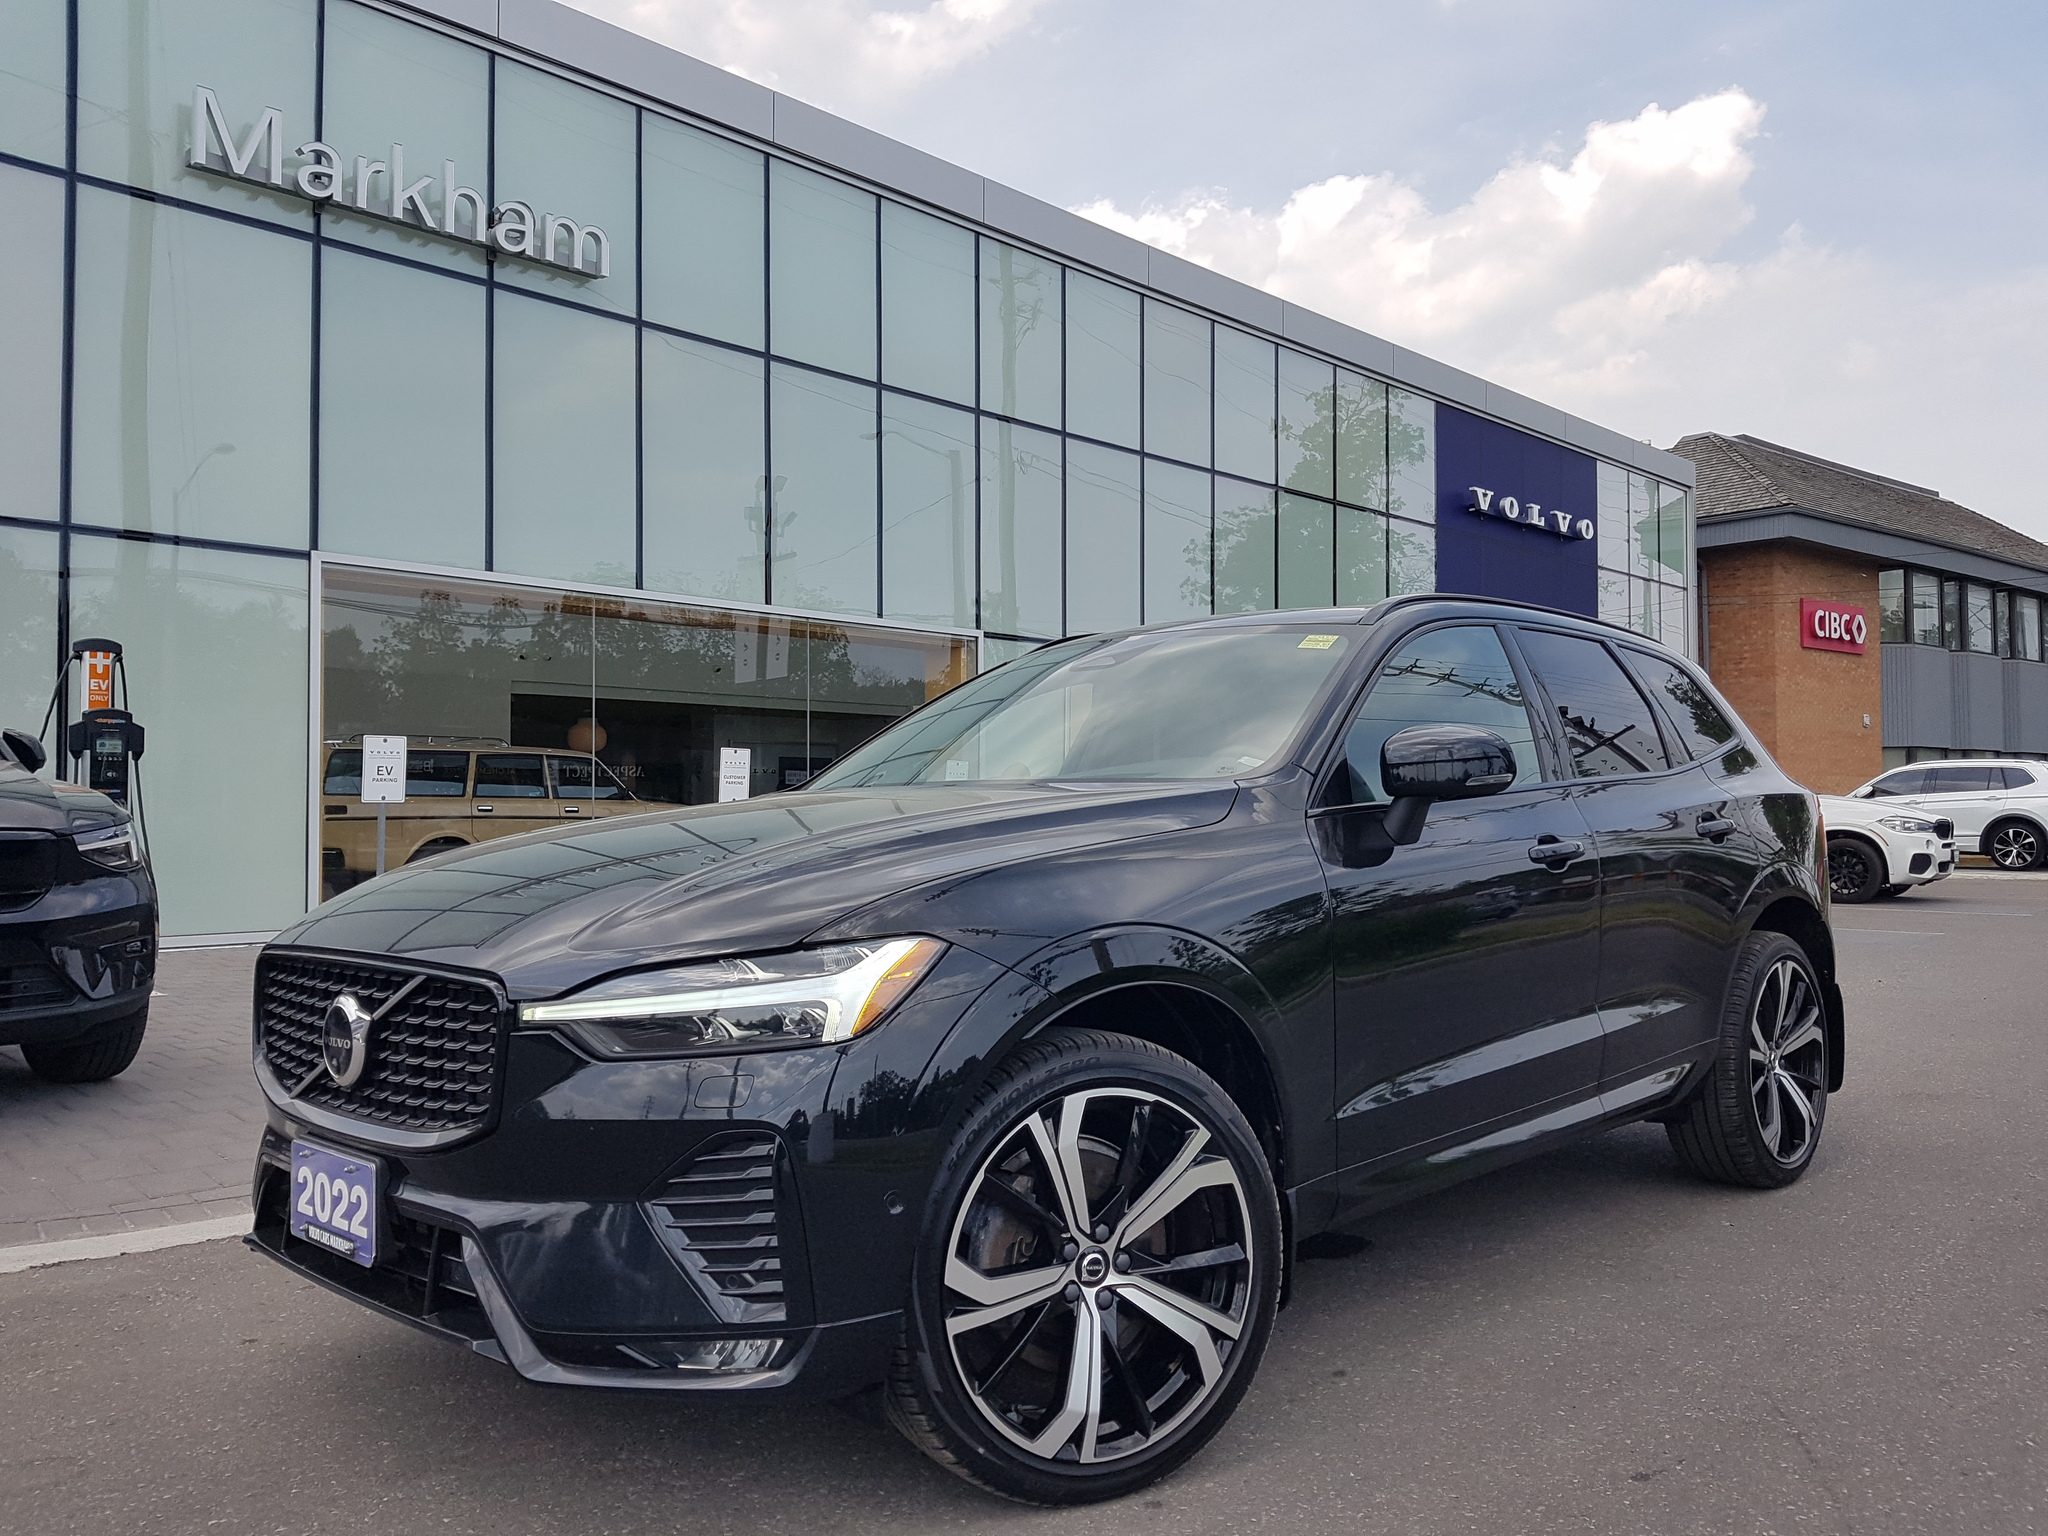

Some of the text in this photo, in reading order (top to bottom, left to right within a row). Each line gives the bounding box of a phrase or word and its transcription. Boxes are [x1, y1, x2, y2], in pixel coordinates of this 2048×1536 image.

[190, 84, 610, 279] Markham
[1469, 486, 1594, 540] VOLVO
[1814, 609, 1851, 641] CIBC
[90, 678, 109, 690] EV
[90, 694, 109, 702] ONLY
[376, 765, 399, 776] EV
[297, 1166, 368, 1239] 2022
